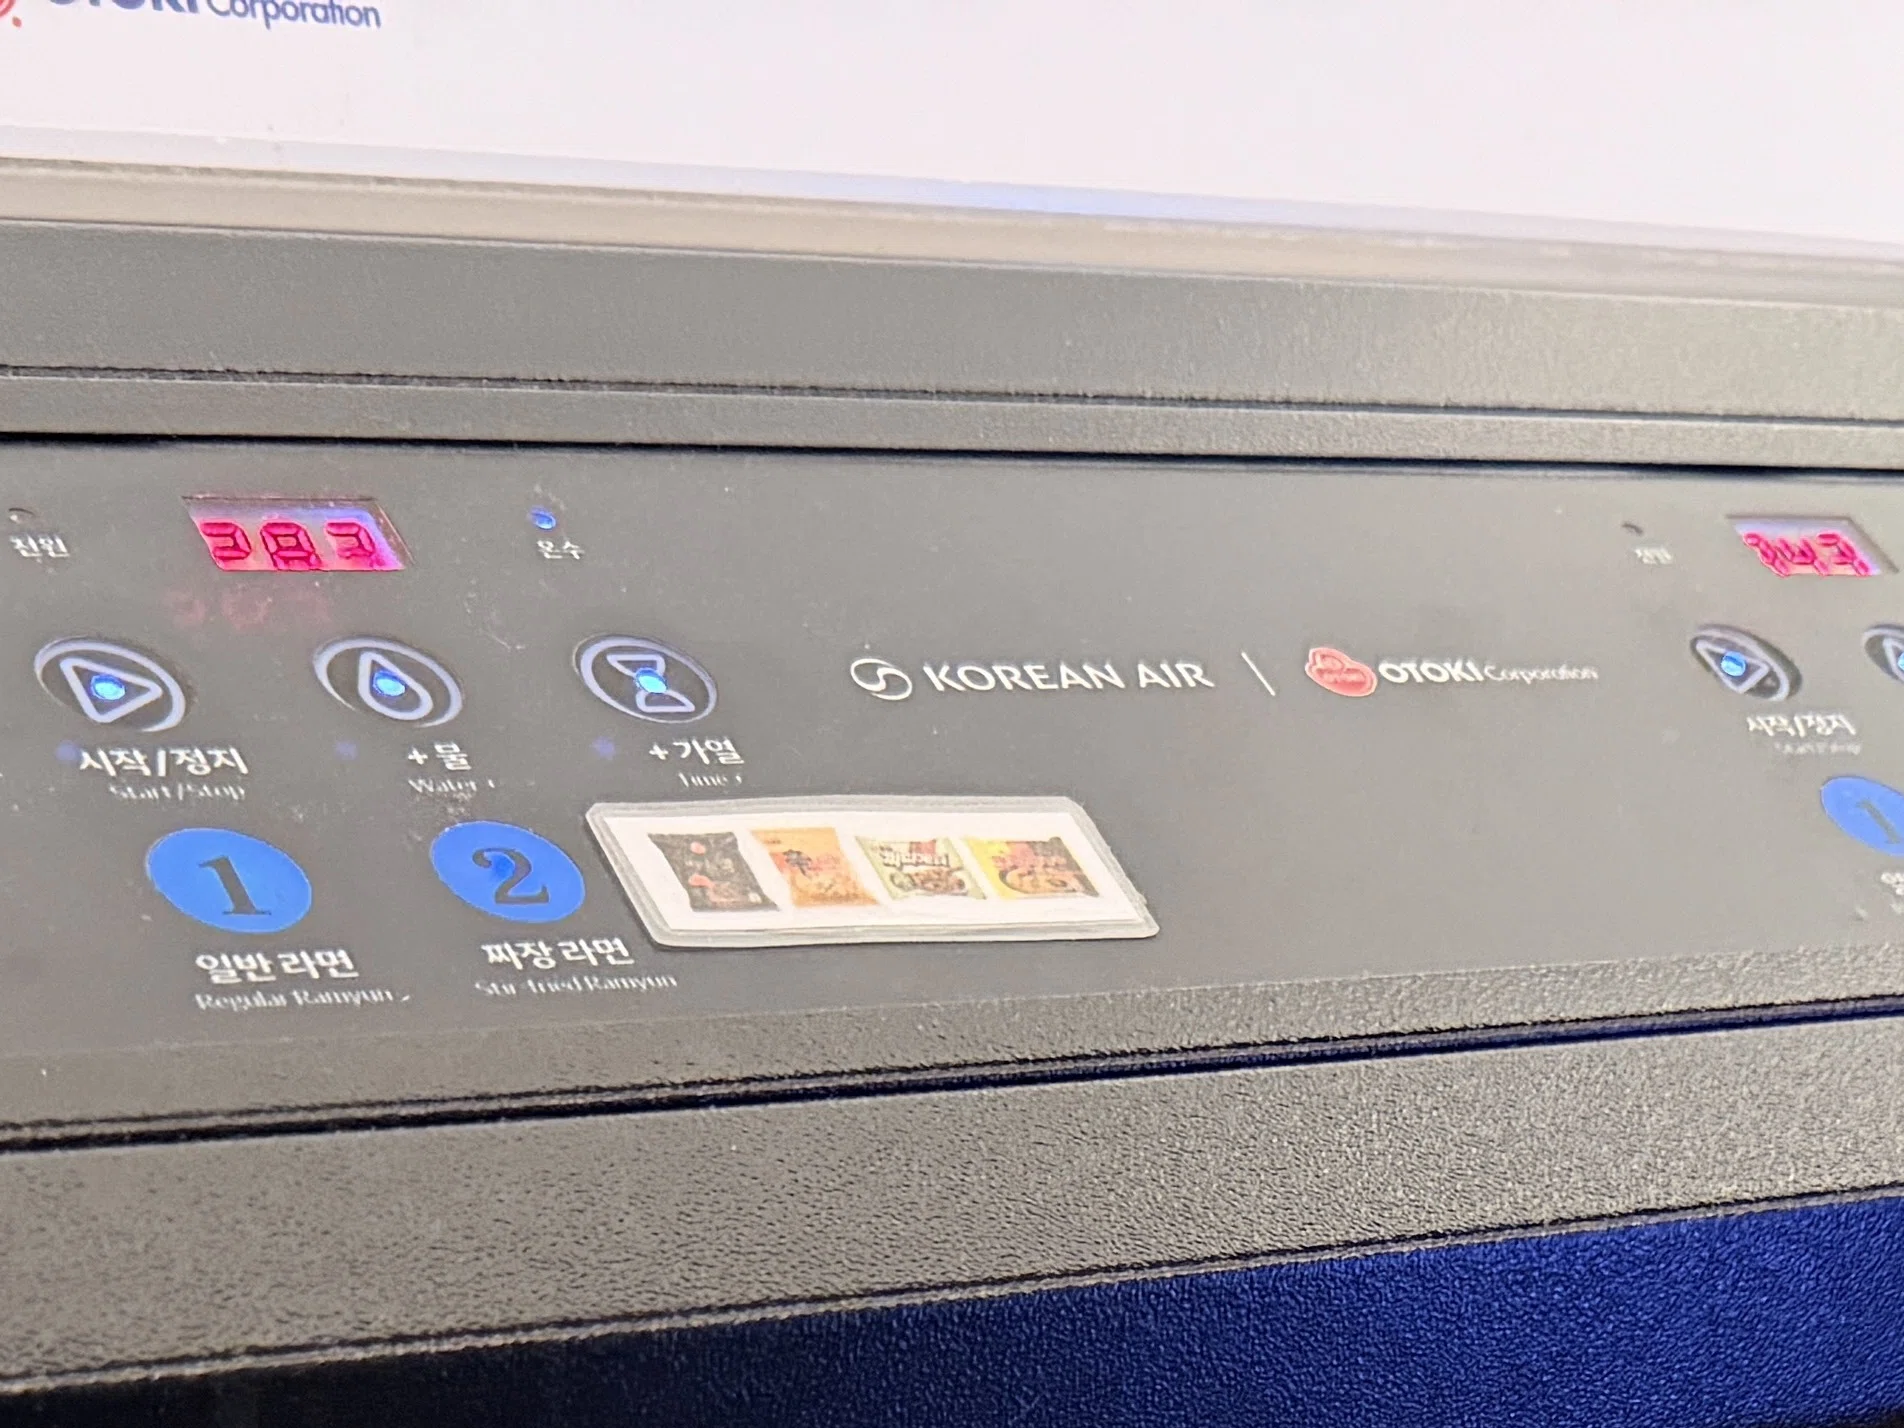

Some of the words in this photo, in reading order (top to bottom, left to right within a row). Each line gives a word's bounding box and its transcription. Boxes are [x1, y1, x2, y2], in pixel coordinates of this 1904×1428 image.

[923, 662, 1125, 691] KOREAN
[1138, 662, 1215, 689] AIR
[1379, 658, 1484, 683] OTOKI
[198, 855, 272, 916] 1
[471, 847, 550, 904] 2
[195, 952, 277, 984] 일반
[276, 949, 359, 979] 라면
[557, 937, 635, 966] 라면
